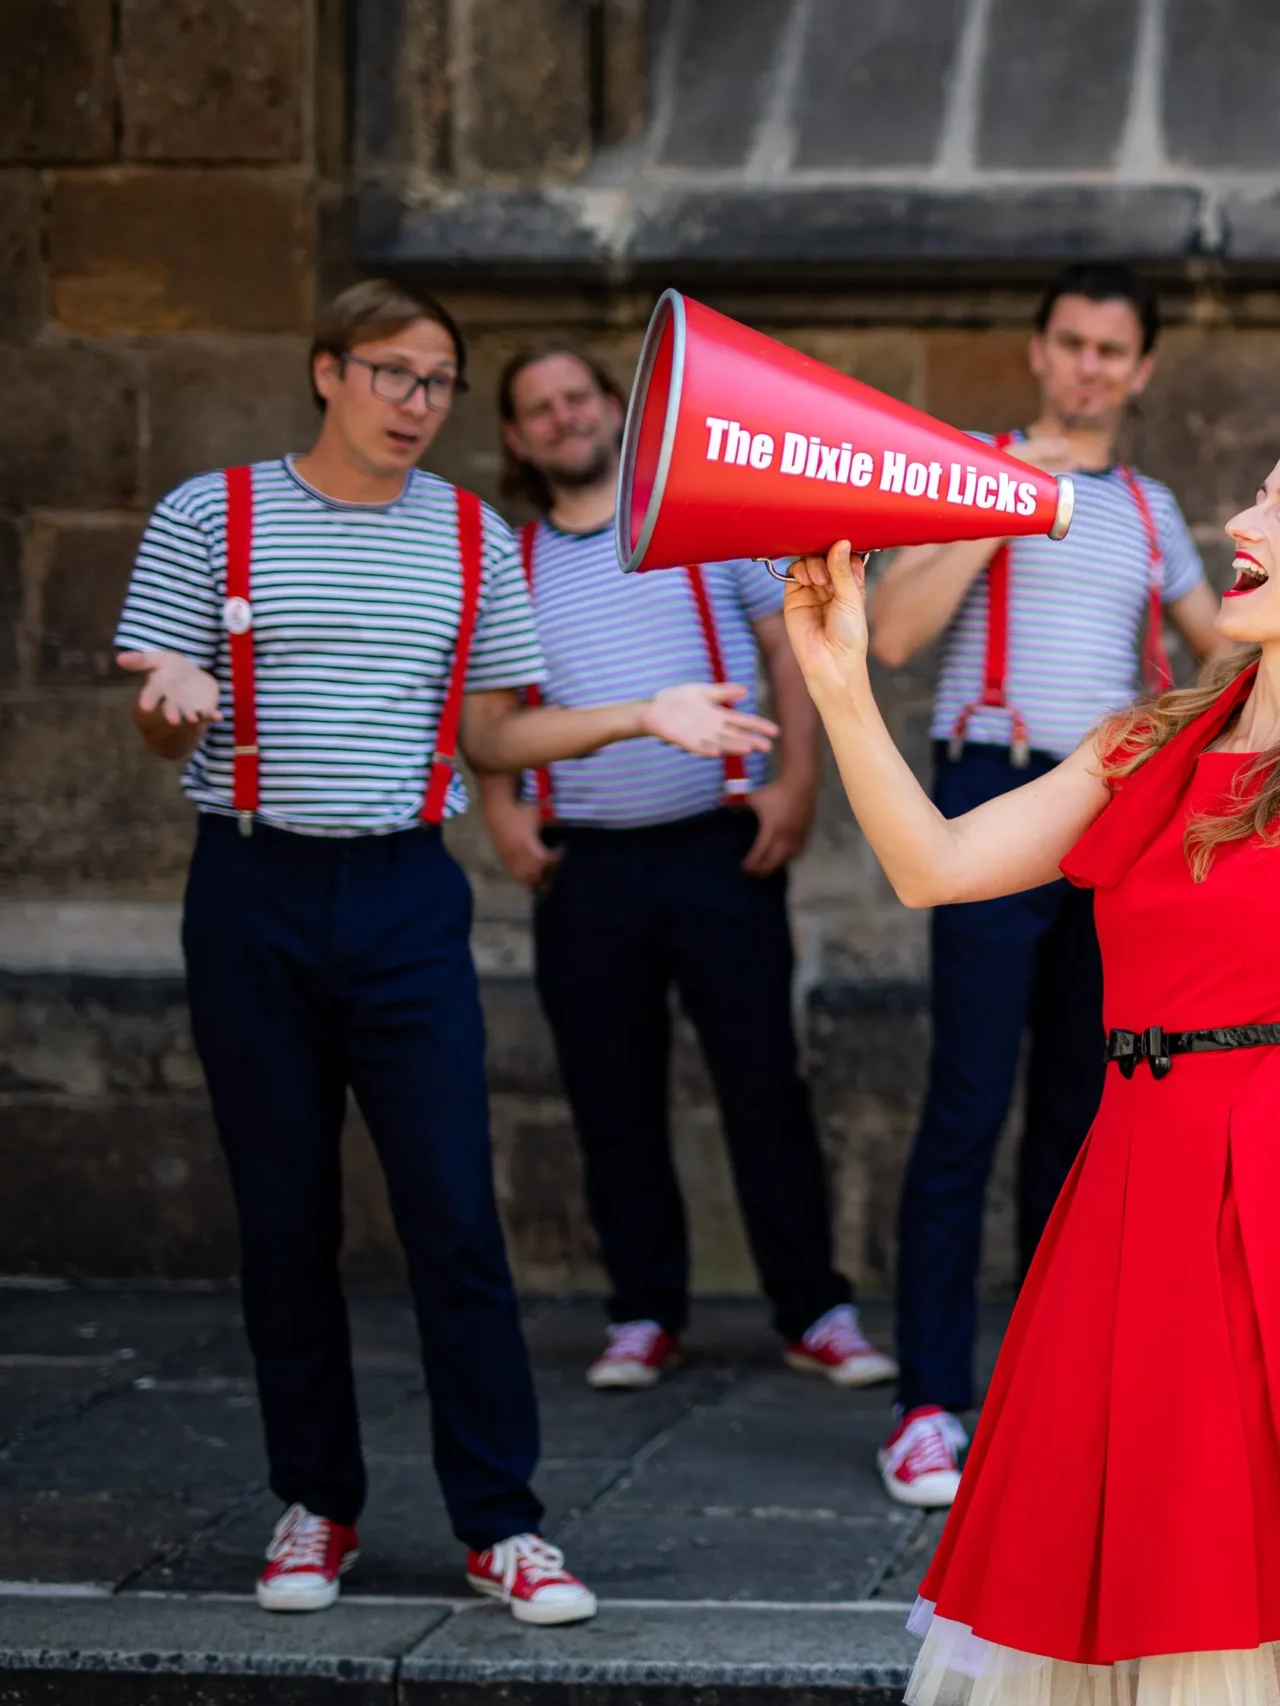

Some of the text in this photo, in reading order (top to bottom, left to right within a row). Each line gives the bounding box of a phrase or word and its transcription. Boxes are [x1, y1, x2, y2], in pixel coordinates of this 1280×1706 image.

[705, 416, 1038, 516] The Dixie Hot Licks
